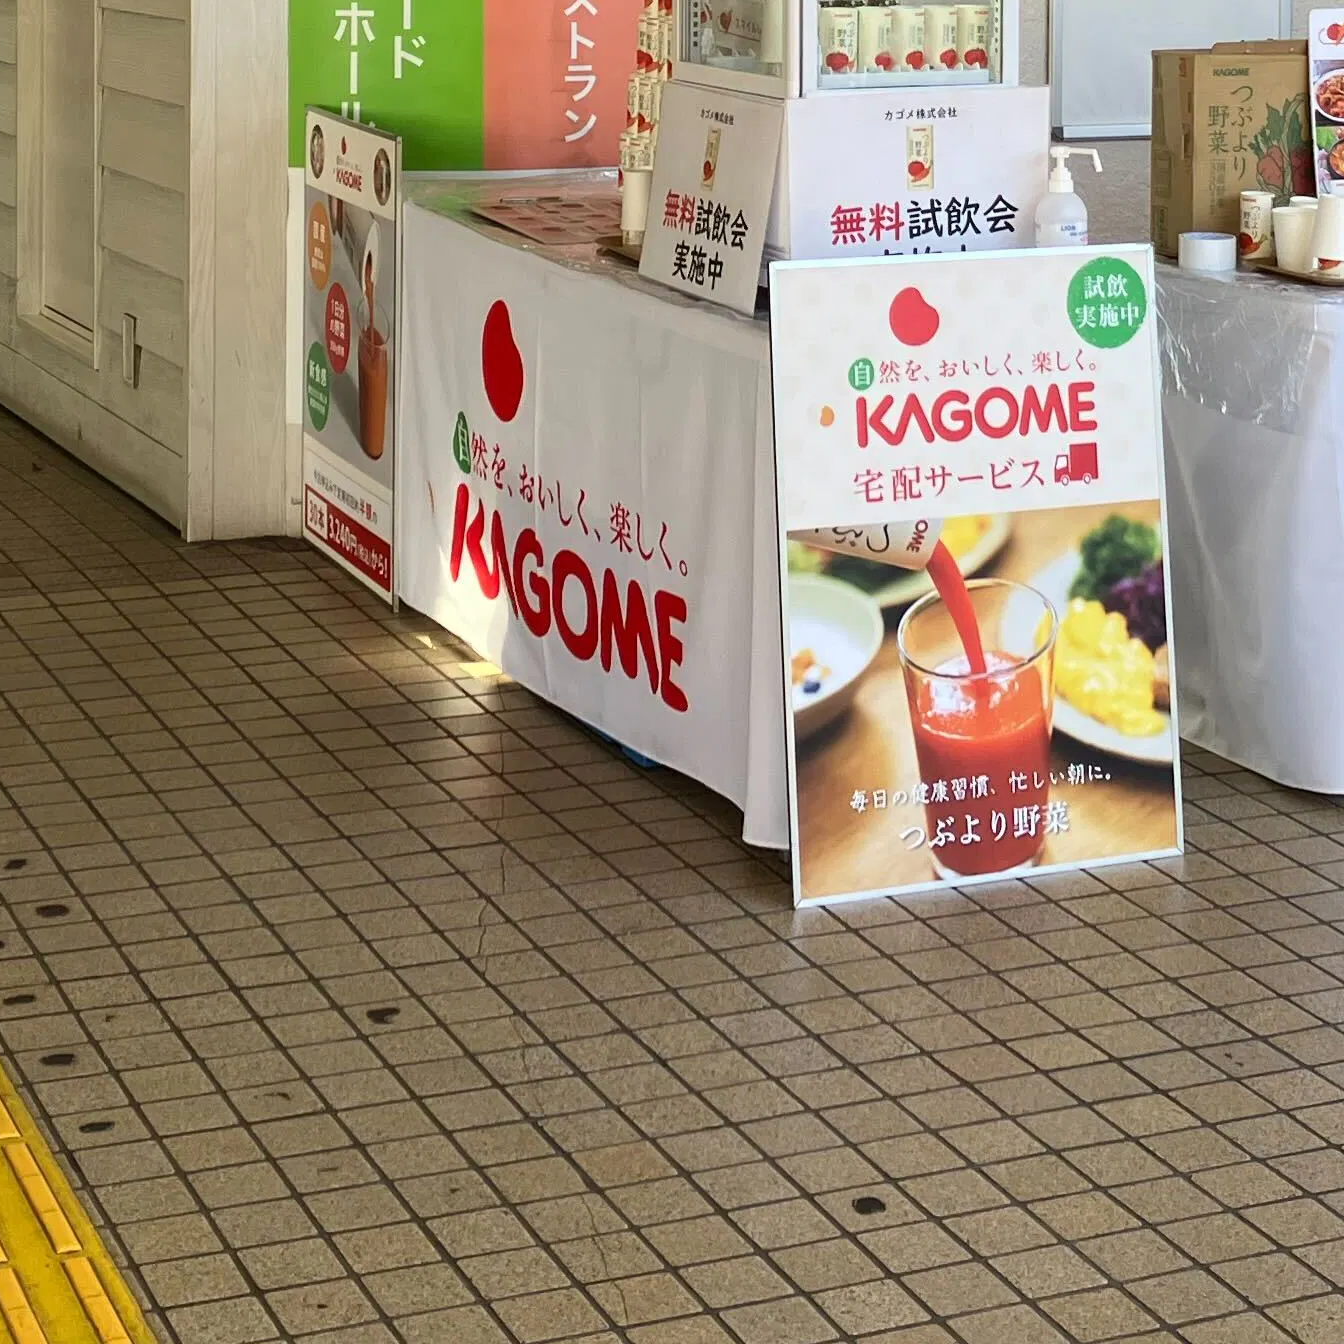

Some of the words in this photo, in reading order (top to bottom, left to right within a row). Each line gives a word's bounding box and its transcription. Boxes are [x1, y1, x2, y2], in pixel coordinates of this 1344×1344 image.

[1212, 67, 1251, 78] KAGOME
[884, 106, 958, 121] カゴメ株式会社
[1207, 105, 1229, 154] 野菜
[662, 187, 749, 252] 無料試飲会
[830, 193, 1019, 246] 無料試飲会
[671, 239, 724, 291] 実施中
[1083, 273, 1130, 299] 試飲
[1074, 302, 1141, 329] 実施中
[855, 381, 1098, 449] KAGOME
[853, 458, 1045, 504] 宅配サービス
[450, 482, 689, 713] KAGOME
[898, 801, 1071, 851] つぶより野菜
